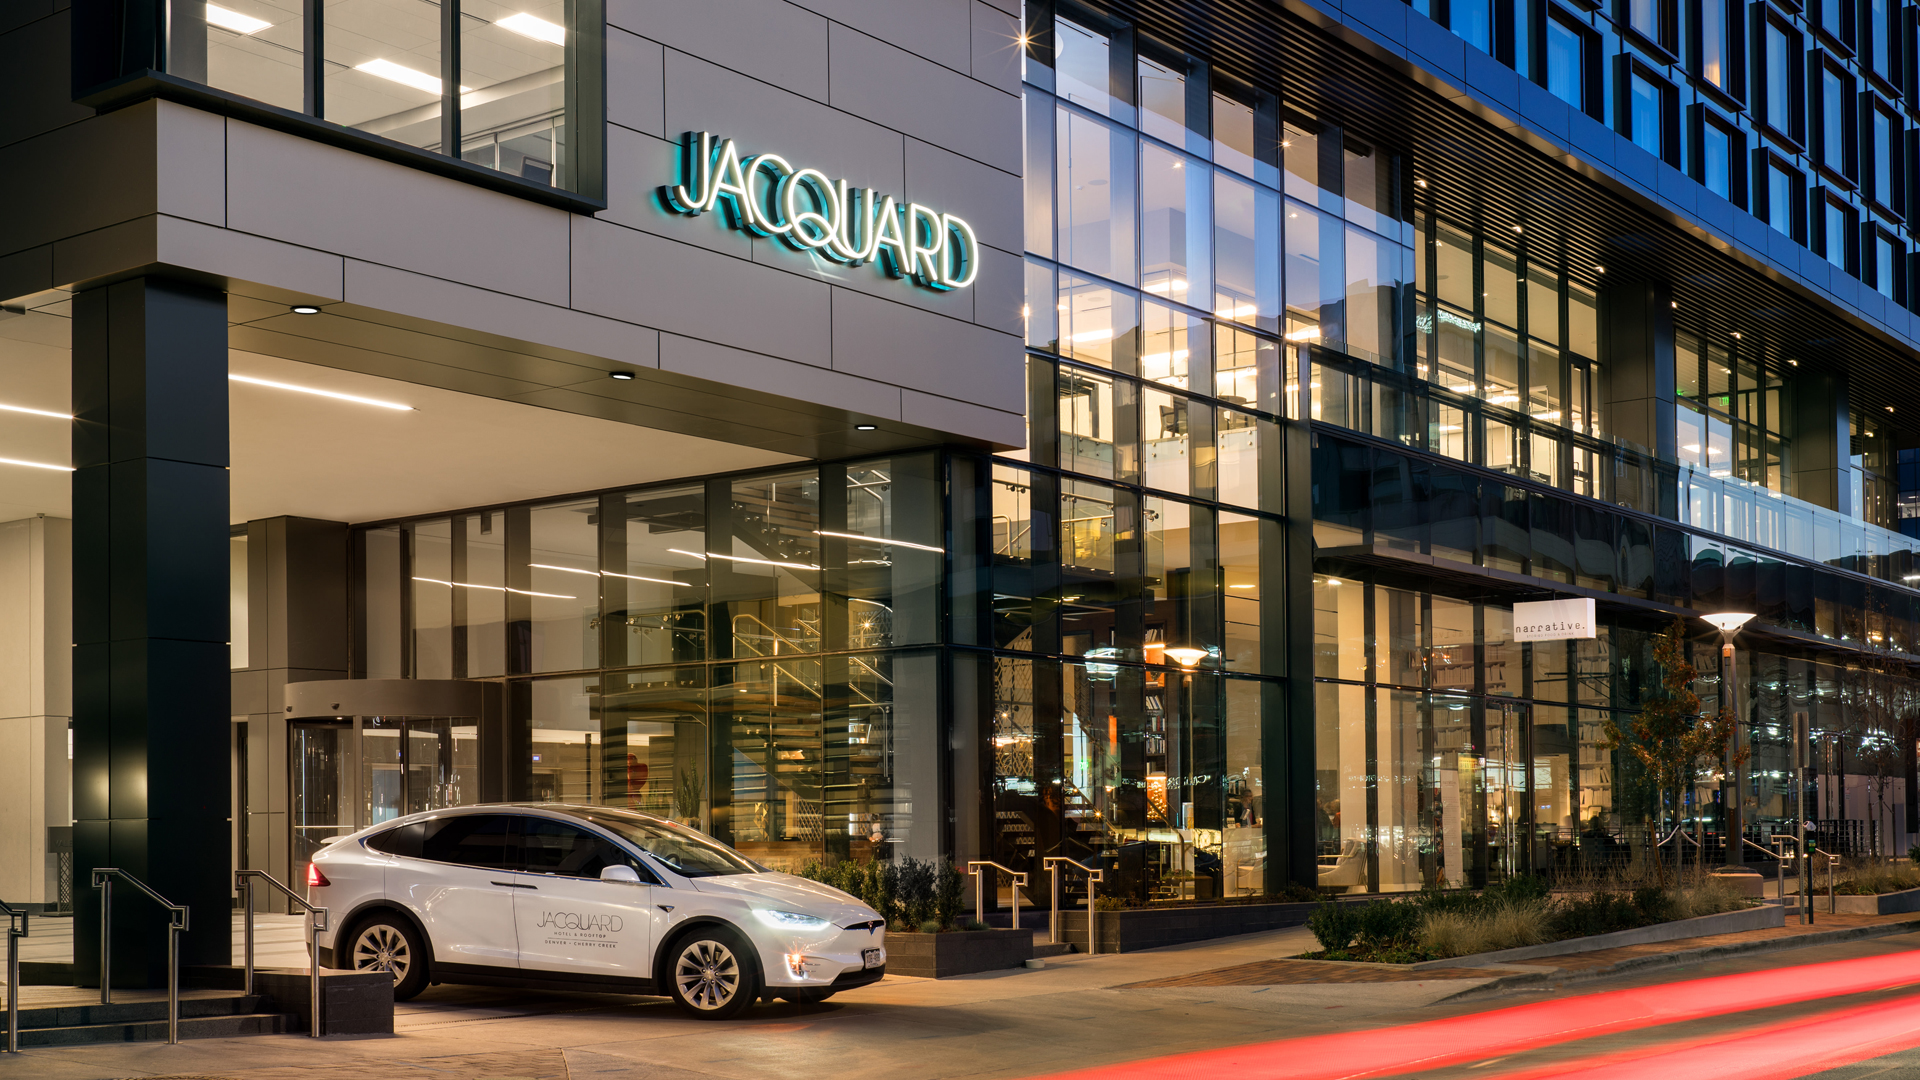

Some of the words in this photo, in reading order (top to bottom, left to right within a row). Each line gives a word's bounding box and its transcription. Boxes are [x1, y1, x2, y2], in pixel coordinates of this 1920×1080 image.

[664, 131, 979, 289] JACQUARD
[1515, 621, 1586, 633] narrative.
[536, 911, 624, 932] JACQUARD
